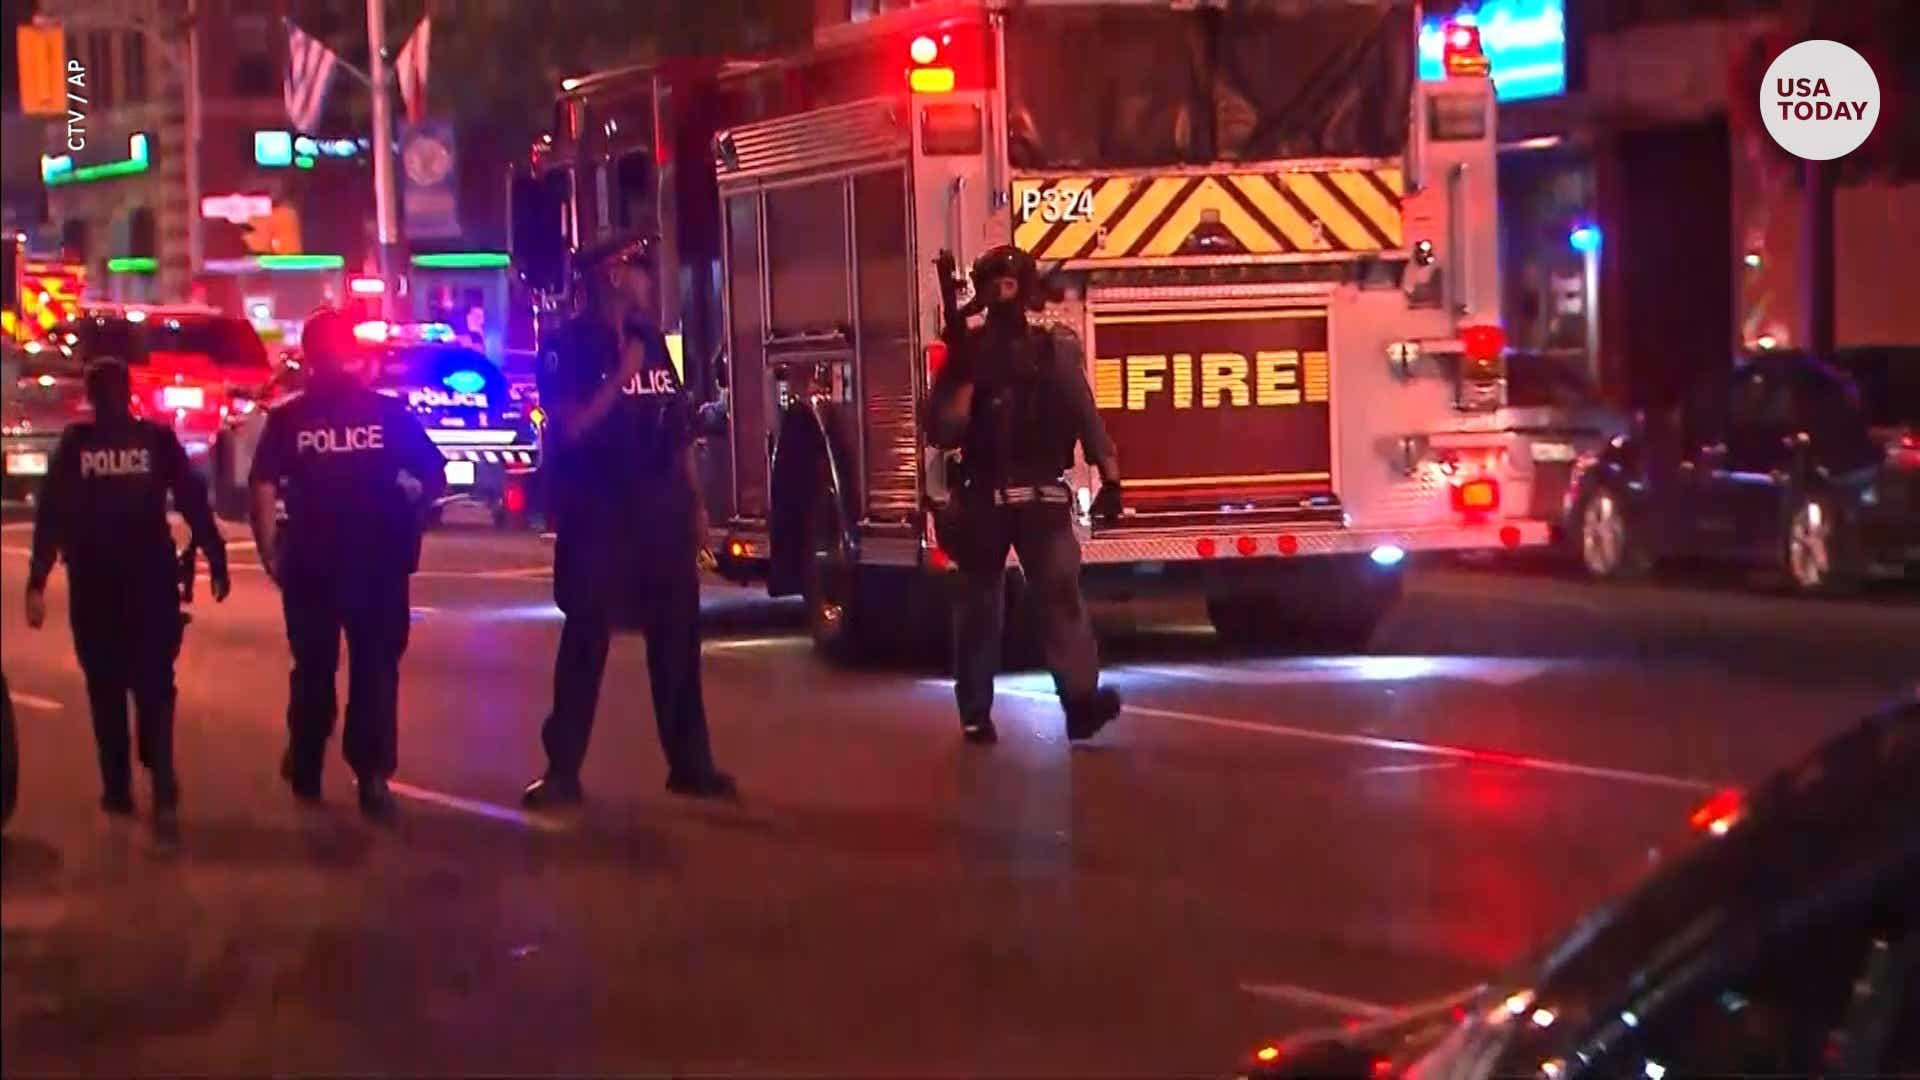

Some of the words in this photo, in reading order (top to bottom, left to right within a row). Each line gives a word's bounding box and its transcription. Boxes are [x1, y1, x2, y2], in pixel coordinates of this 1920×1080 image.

[1022, 188, 1094, 222] P324
[622, 369, 677, 395] OLICE
[1126, 350, 1301, 410] FIRE
[408, 388, 488, 408] POLICE
[297, 424, 385, 454] POLICE
[80, 448, 151, 479] POLICE
